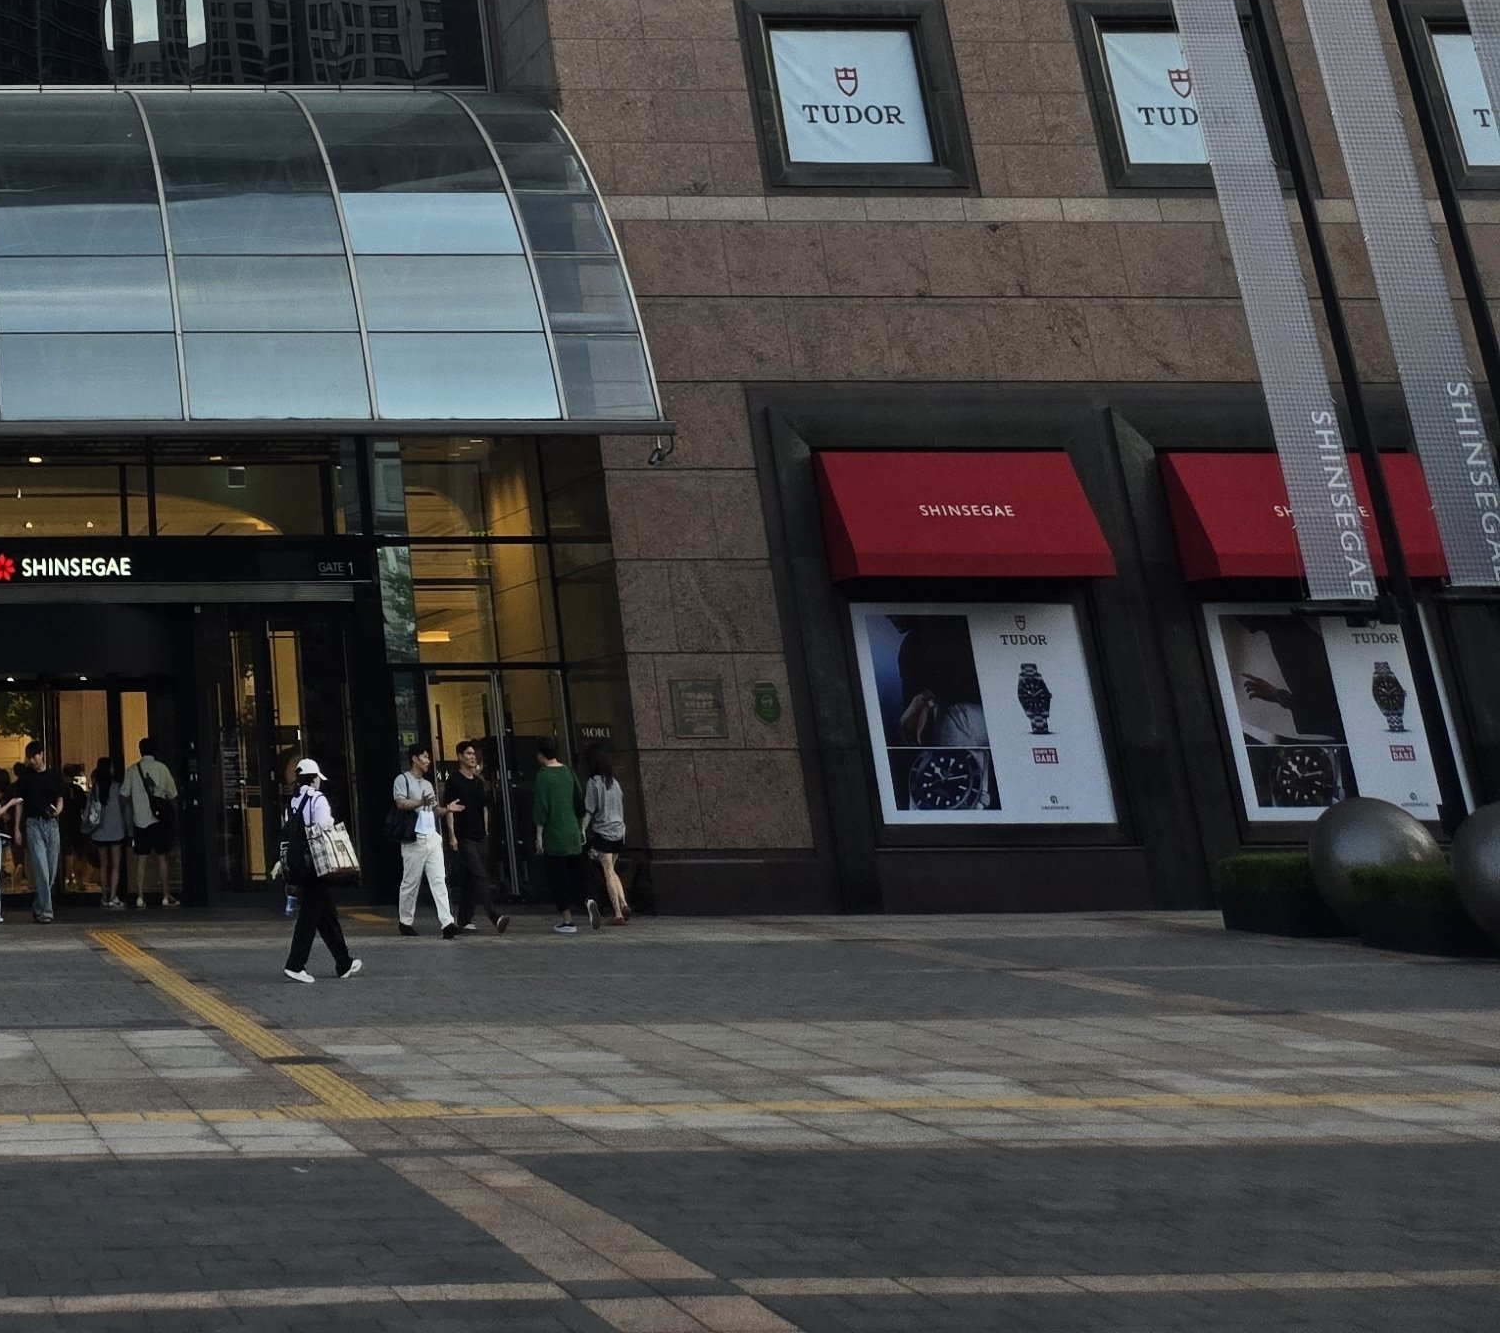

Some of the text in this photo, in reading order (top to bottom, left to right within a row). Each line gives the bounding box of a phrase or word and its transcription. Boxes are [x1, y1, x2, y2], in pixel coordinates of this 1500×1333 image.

[802, 104, 905, 125] TUDOR
[1137, 106, 1199, 126] TUD
[918, 503, 1016, 518] SHINSEGAE
[1311, 410, 1373, 596] SHINSEGAE
[21, 557, 132, 577] SHINSEGAE
[318, 562, 354, 575] GATE 1
[1000, 634, 1048, 646] TUDOR
[1352, 633, 1400, 644] TUDOR
